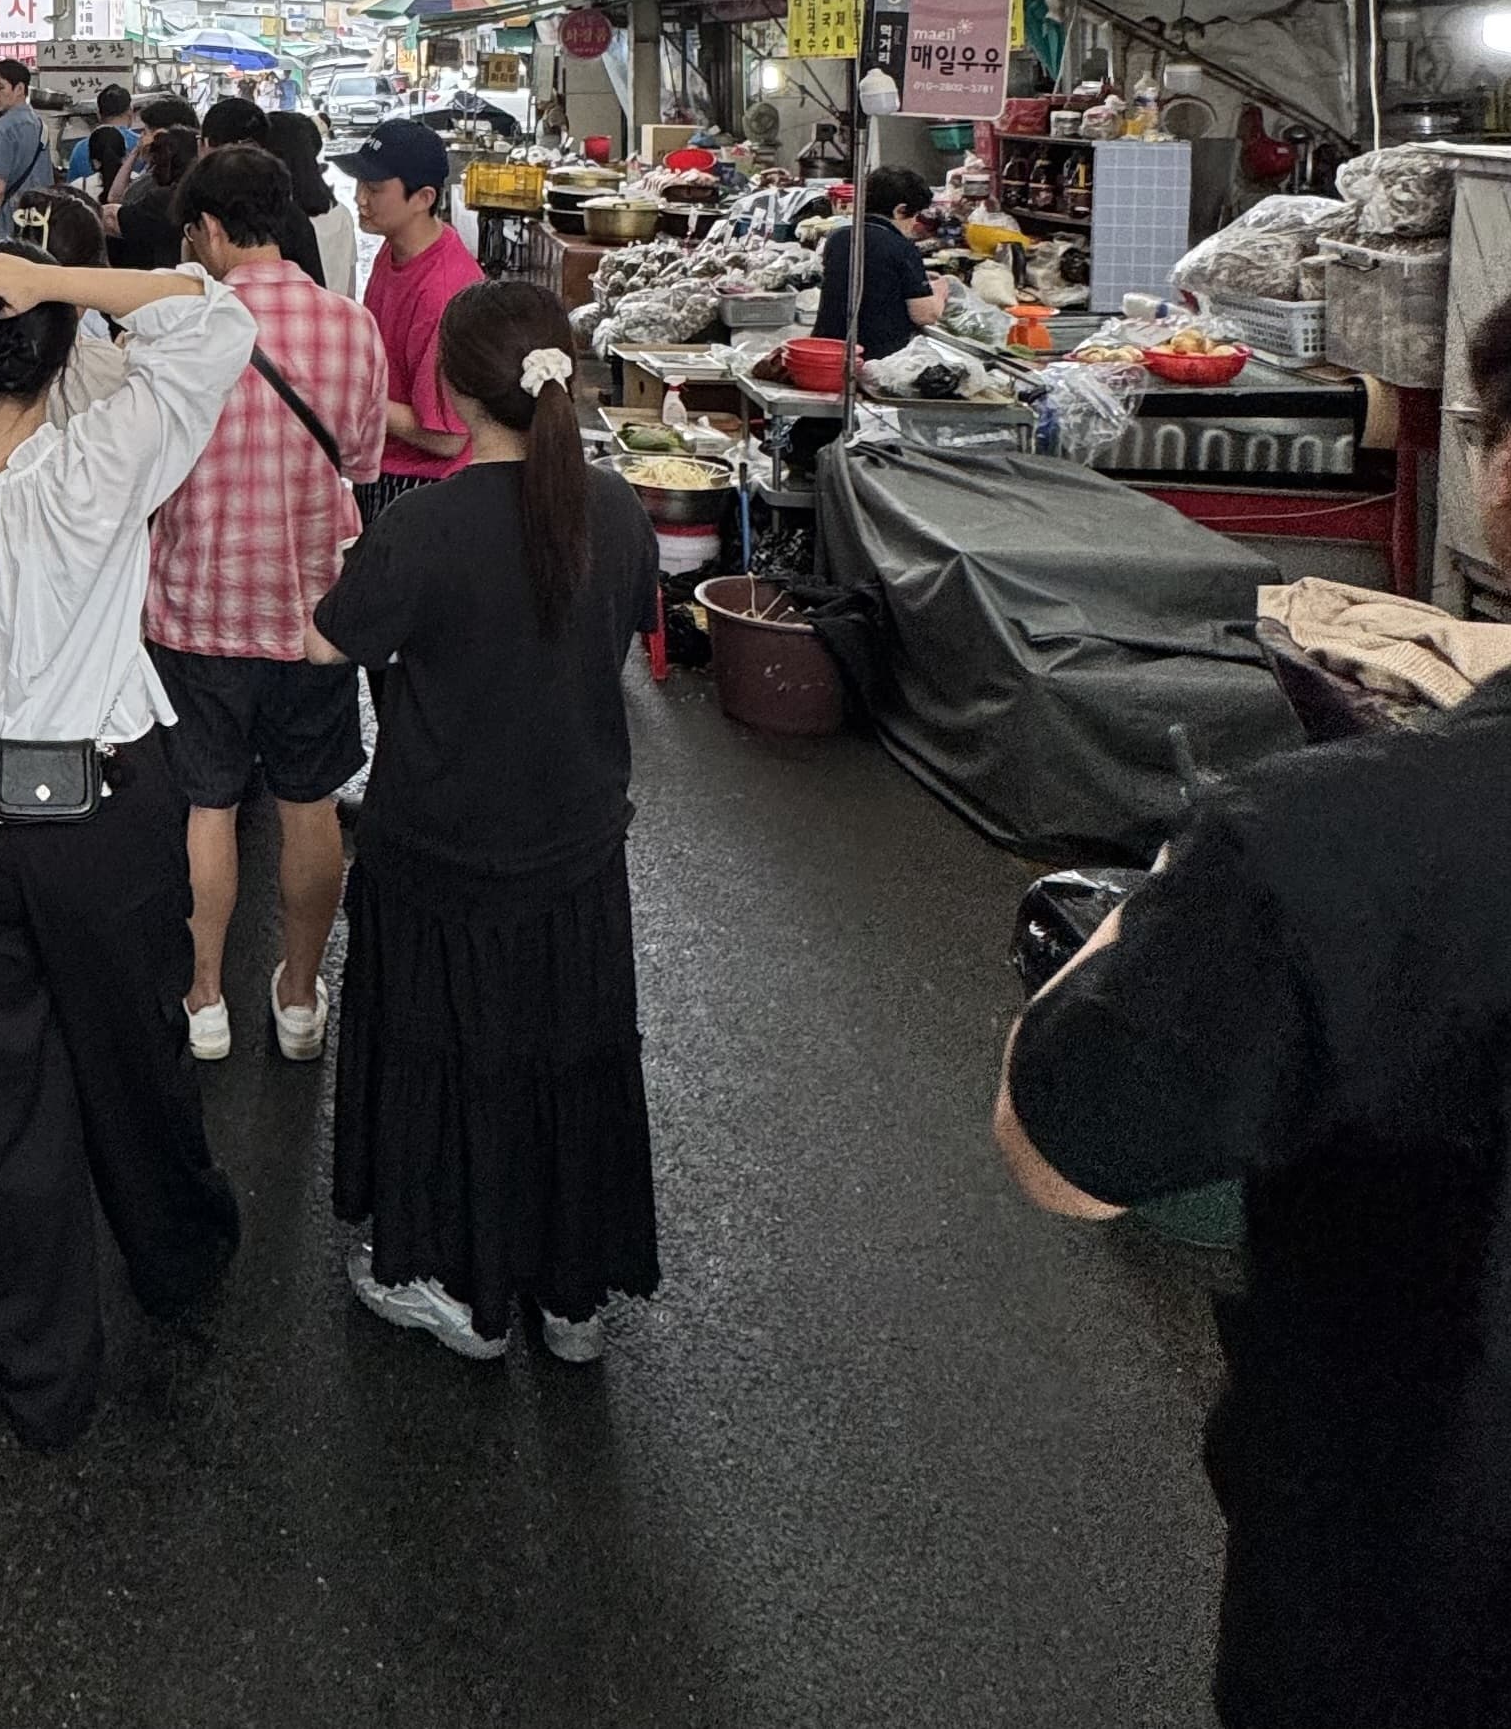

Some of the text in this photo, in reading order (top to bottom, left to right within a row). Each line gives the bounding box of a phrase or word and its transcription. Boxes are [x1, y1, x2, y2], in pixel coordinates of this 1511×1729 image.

[912, 27, 956, 41] maeil
[910, 43, 1003, 76] 매일우유
[69, 77, 104, 94] 반찬
